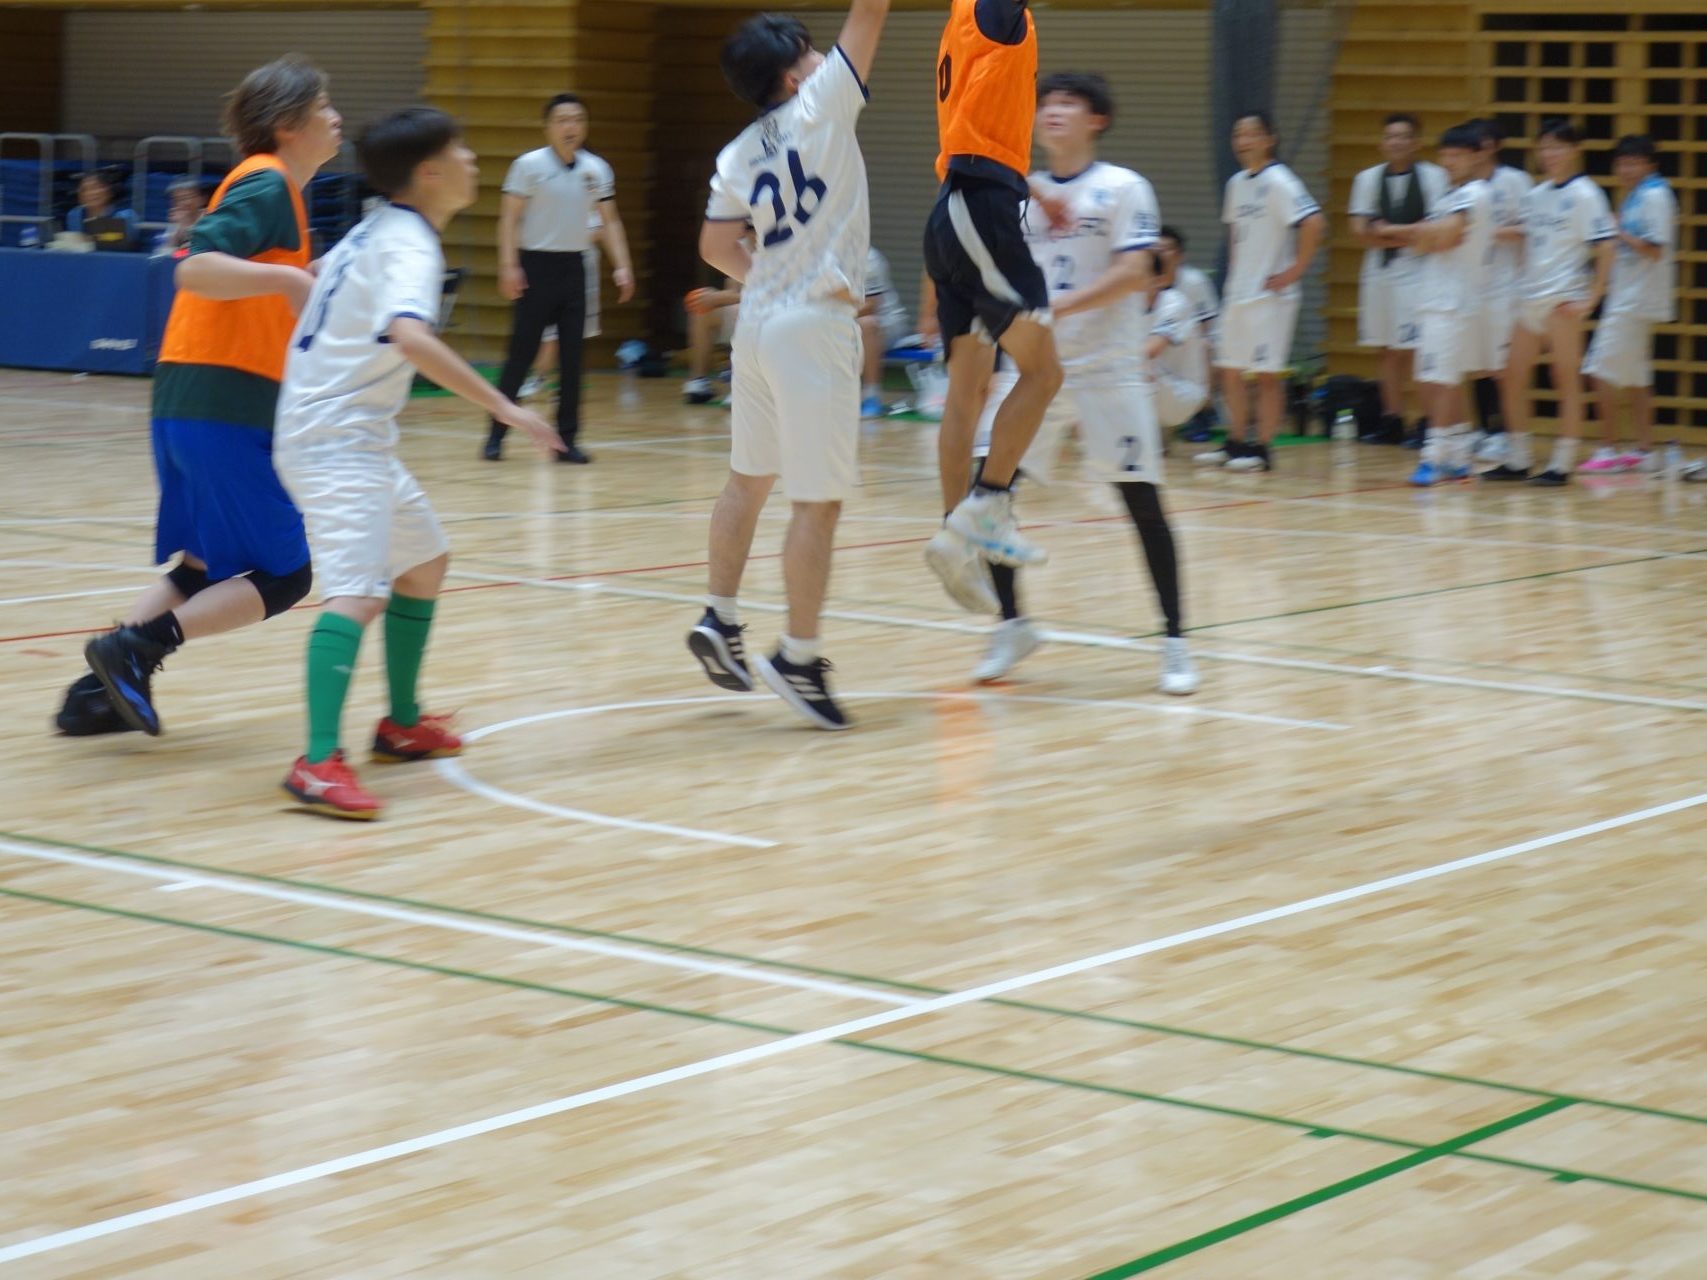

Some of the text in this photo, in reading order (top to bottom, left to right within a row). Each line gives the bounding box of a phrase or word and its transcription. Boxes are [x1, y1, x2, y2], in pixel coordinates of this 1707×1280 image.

[749, 148, 828, 248] 26
[1052, 253, 1075, 291] 2
[1117, 435, 1144, 472] 2
